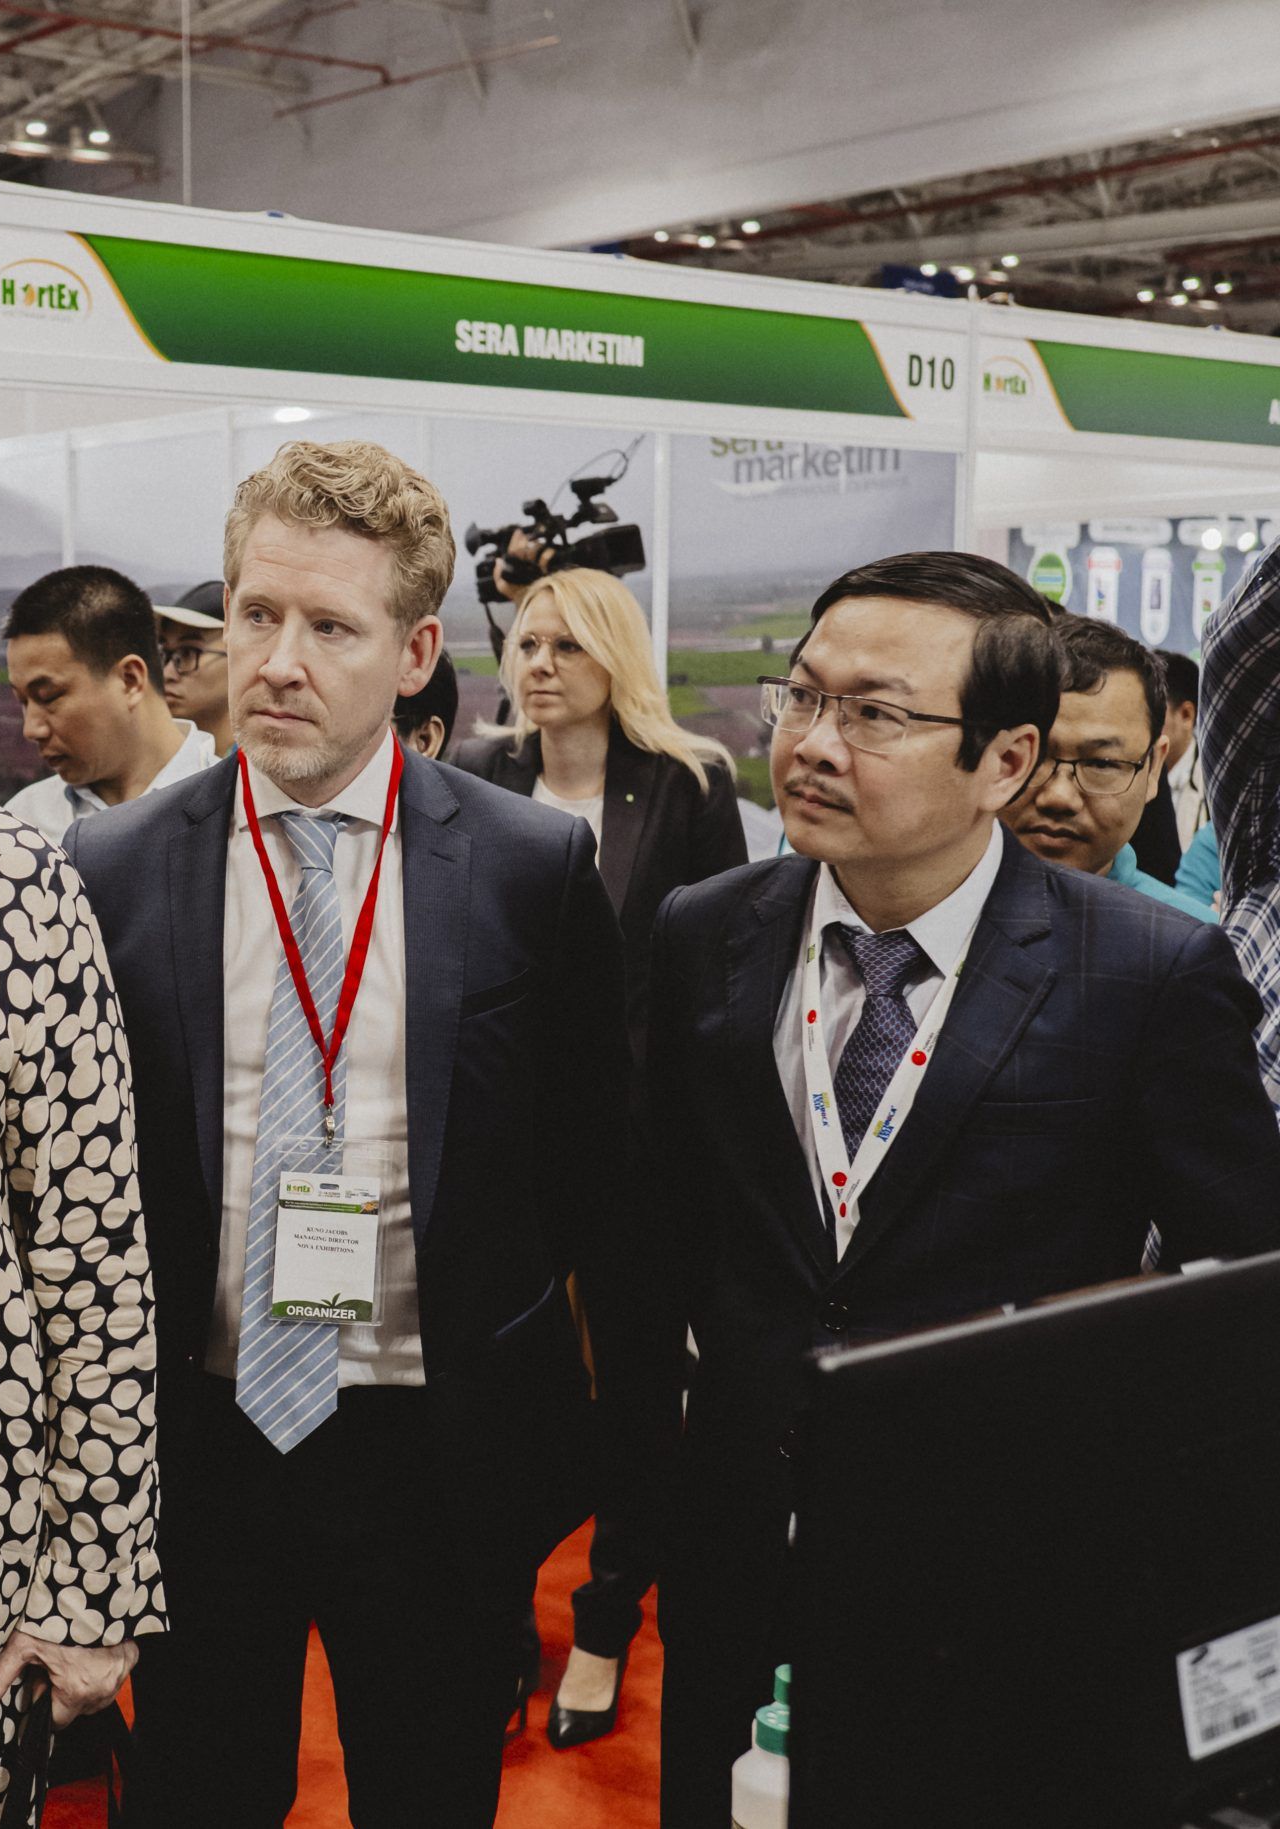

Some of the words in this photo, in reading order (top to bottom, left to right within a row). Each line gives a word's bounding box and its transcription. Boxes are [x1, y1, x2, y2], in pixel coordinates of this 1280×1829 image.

[455, 319, 519, 357] SERA
[523, 325, 644, 368] MARKETIM
[908, 354, 955, 390] D10
[294, 1233, 327, 1242] MANAGING
[328, 1236, 359, 1245] DIRECTOR
[316, 1244, 354, 1254] EXHIBITIONS
[286, 1305, 356, 1320] ORGANIZER
